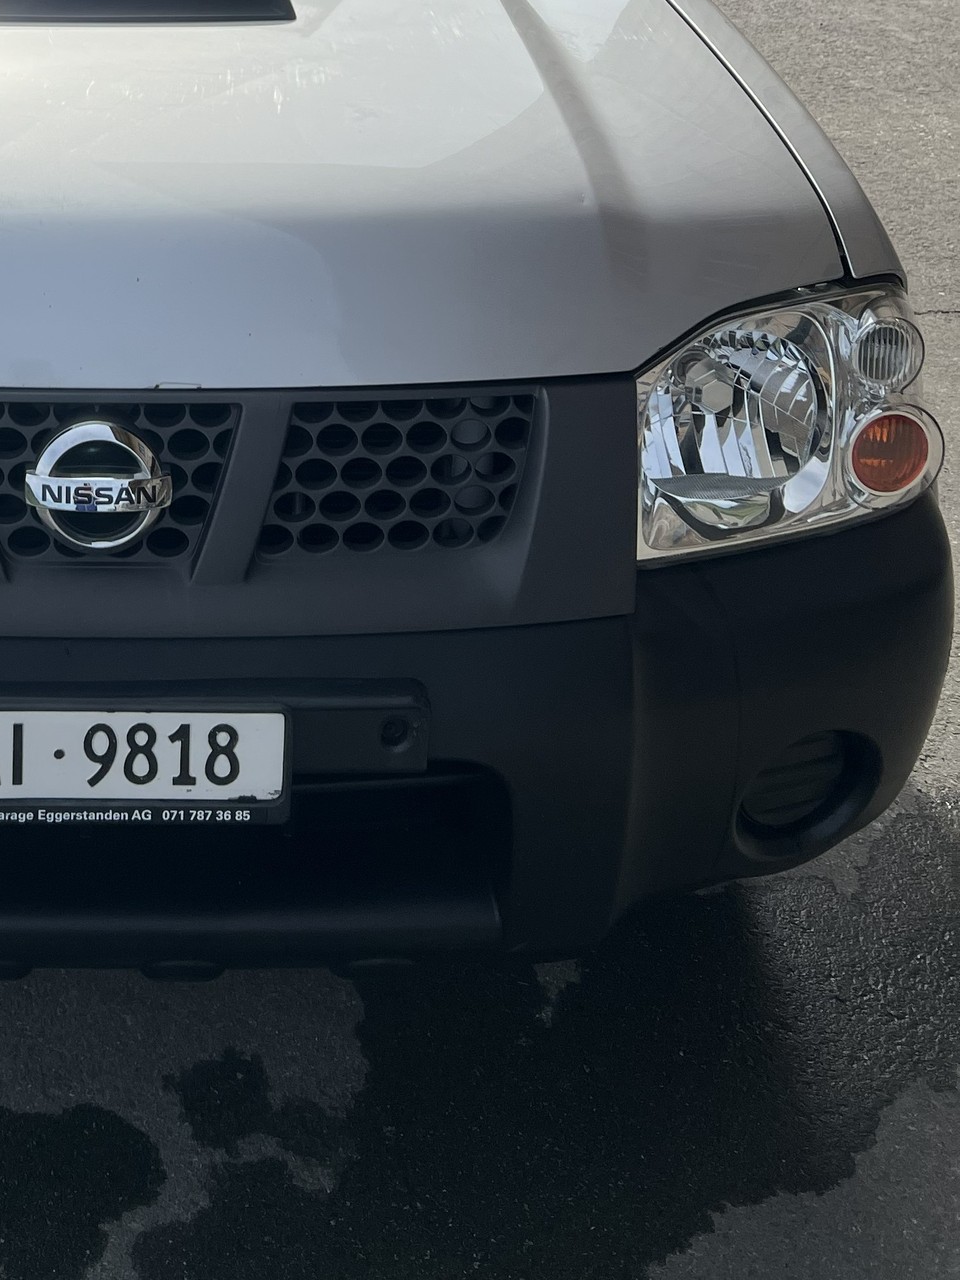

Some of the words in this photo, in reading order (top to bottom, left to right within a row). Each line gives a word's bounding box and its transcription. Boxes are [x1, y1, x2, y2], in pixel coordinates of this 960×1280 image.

[41, 484, 157, 505] NISSAN
[83, 722, 240, 788] 9818
[37, 809, 129, 823] Eggerstanden
[131, 809, 152, 821] AG
[162, 809, 184, 821] 071
[189, 809, 212, 821] 787
[215, 809, 231, 821] 36
[235, 809, 251, 821] 85
